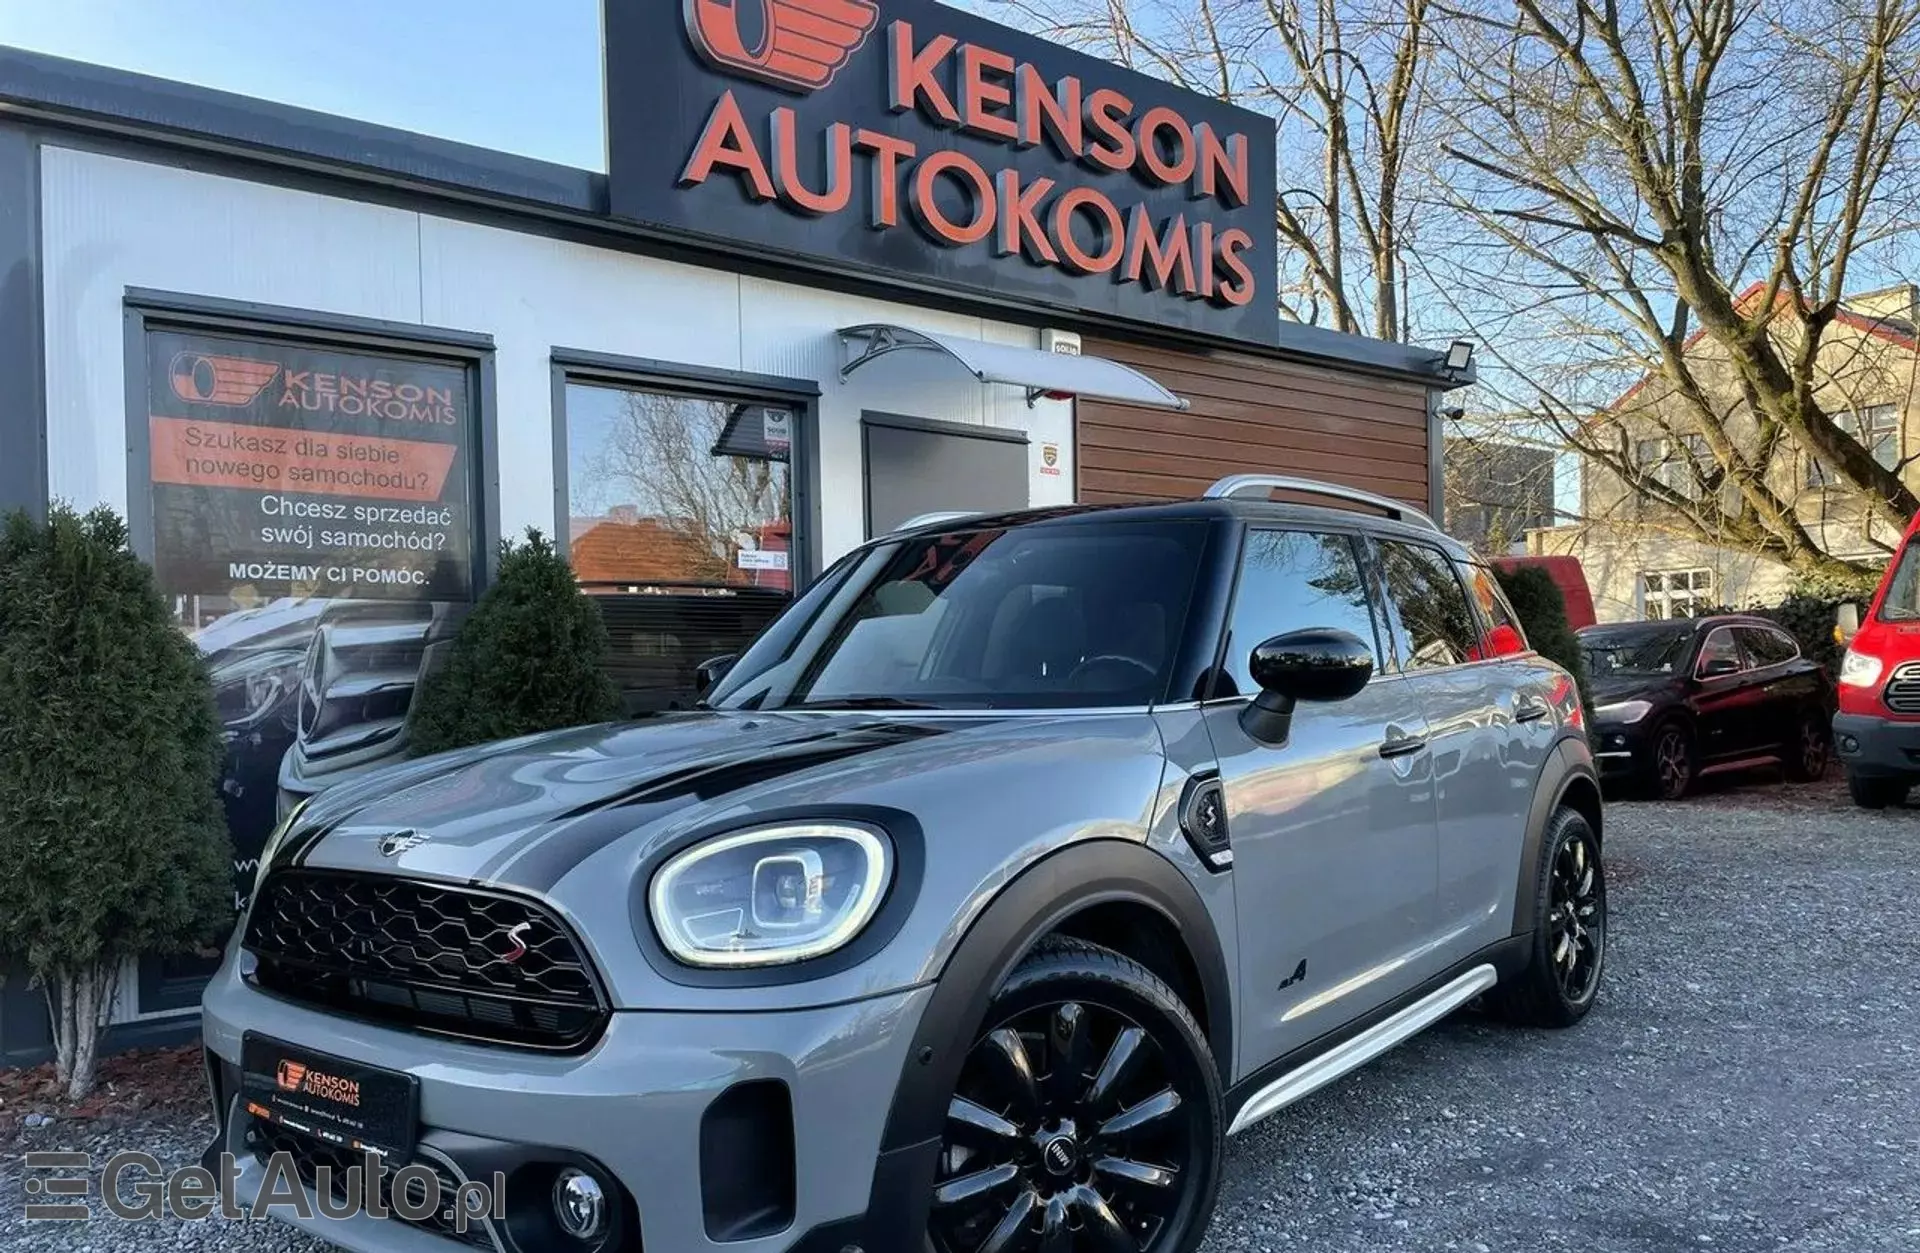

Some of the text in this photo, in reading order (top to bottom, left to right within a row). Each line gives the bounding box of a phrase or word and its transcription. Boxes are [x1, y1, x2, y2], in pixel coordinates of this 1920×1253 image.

[887, 19, 1249, 208] KENSON
[679, 88, 1255, 307] AUTOKOMIS
[283, 368, 451, 405] KENSON
[278, 390, 457, 426] AUTOKOMIS
[184, 426, 399, 465] Szukasz dla siebie
[185, 457, 429, 492] nowego samochodu?
[260, 494, 451, 527] Chcesz sprzedać
[261, 523, 446, 551] swój samochód?
[229, 560, 430, 586] MOŻEMY CI POMÓC.
[302, 1082, 360, 1107] AUTOKOMIS
[305, 1069, 360, 1094] KENSON
